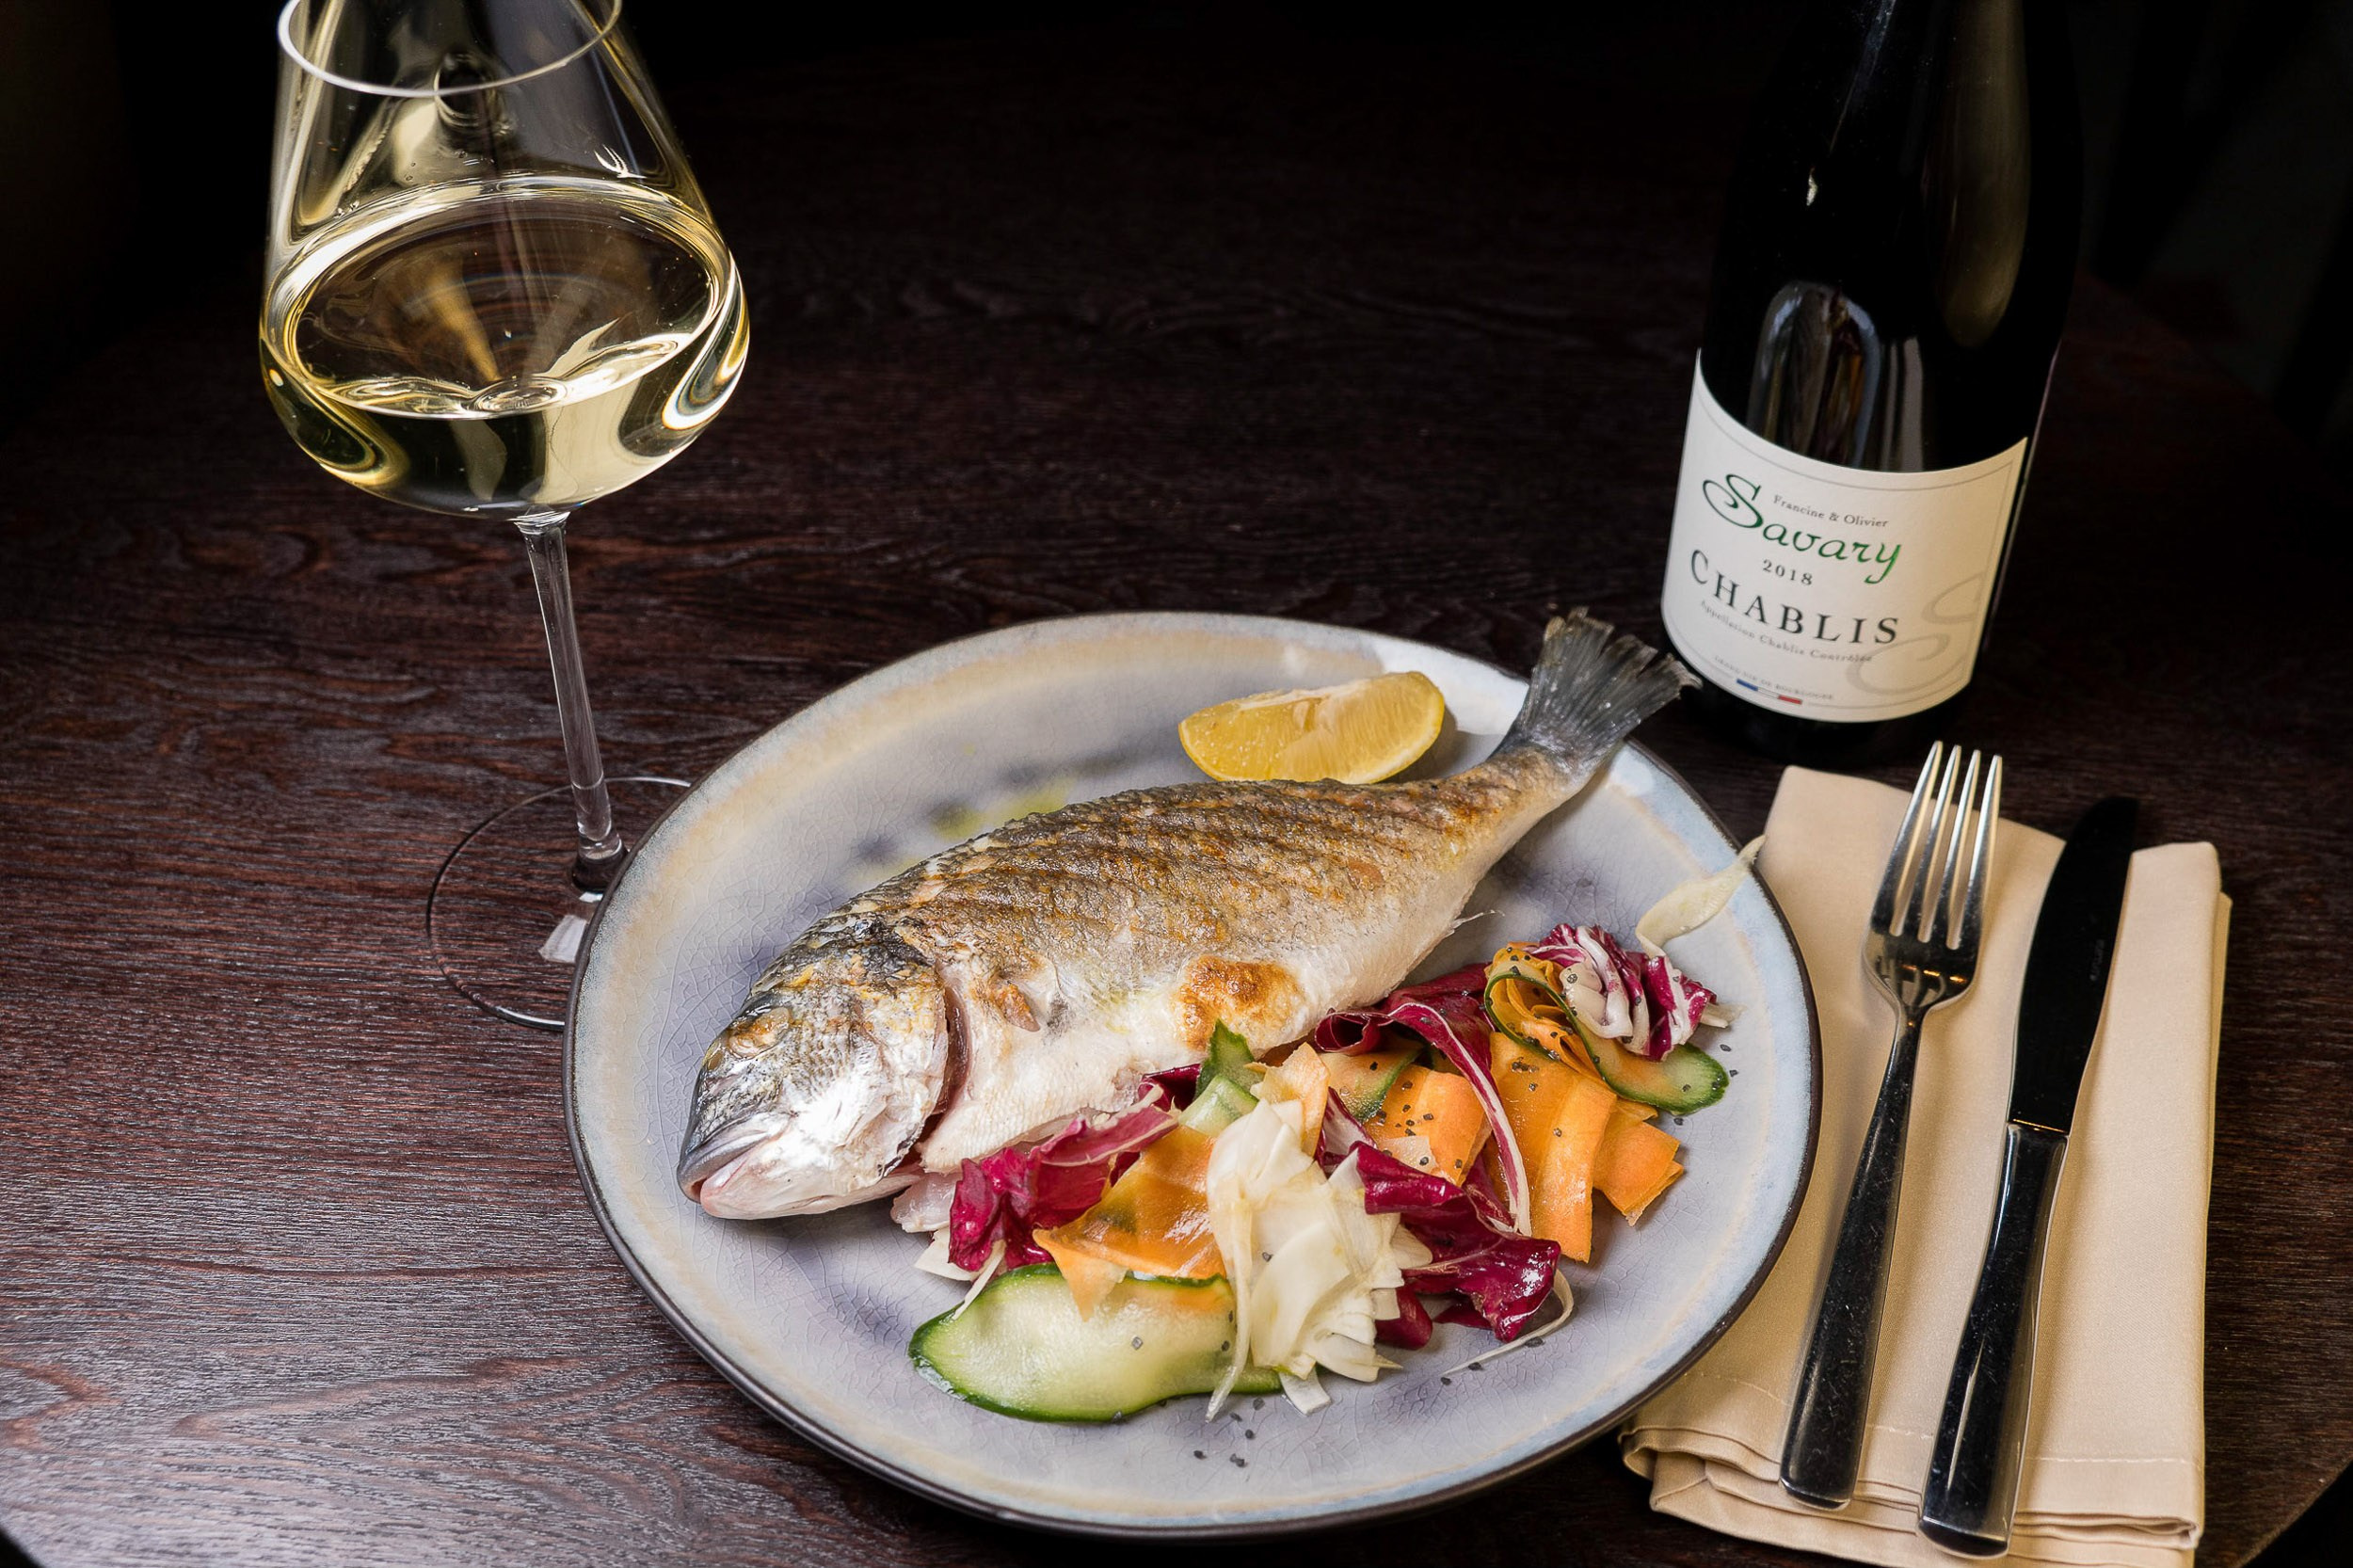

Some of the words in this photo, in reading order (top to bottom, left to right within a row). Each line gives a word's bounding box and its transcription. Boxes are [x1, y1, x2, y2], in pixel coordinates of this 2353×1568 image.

[1703, 474, 1901, 584] Savary
[1772, 494, 1825, 519] Francine
[1829, 512, 1839, 521] &
[1844, 514, 1889, 528] Olivier
[1690, 549, 1899, 645] CHABLIS
[1763, 559, 1813, 585] 2018
